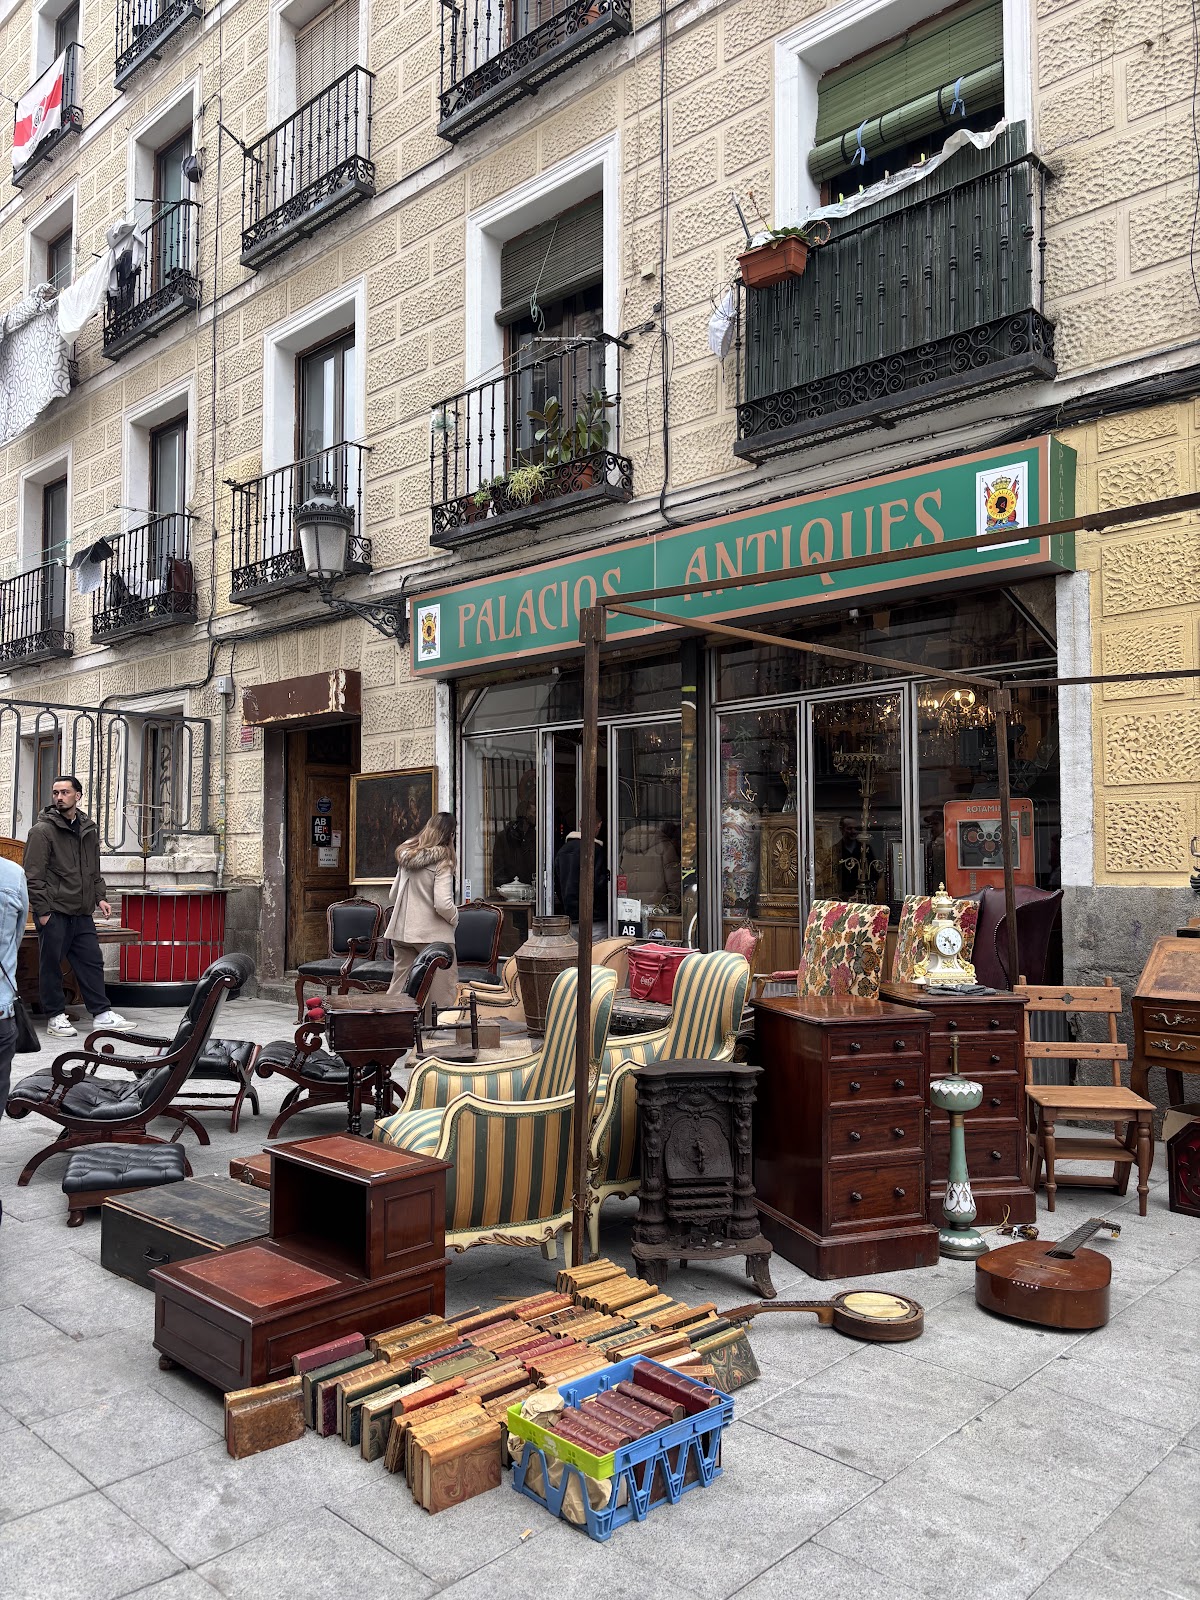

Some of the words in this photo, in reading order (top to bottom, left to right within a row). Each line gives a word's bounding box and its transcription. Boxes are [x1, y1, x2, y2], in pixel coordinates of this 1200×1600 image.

[457, 566, 621, 649] PALACIOS
[684, 487, 945, 602] ANTIQUES
[621, 925, 636, 936] AB
